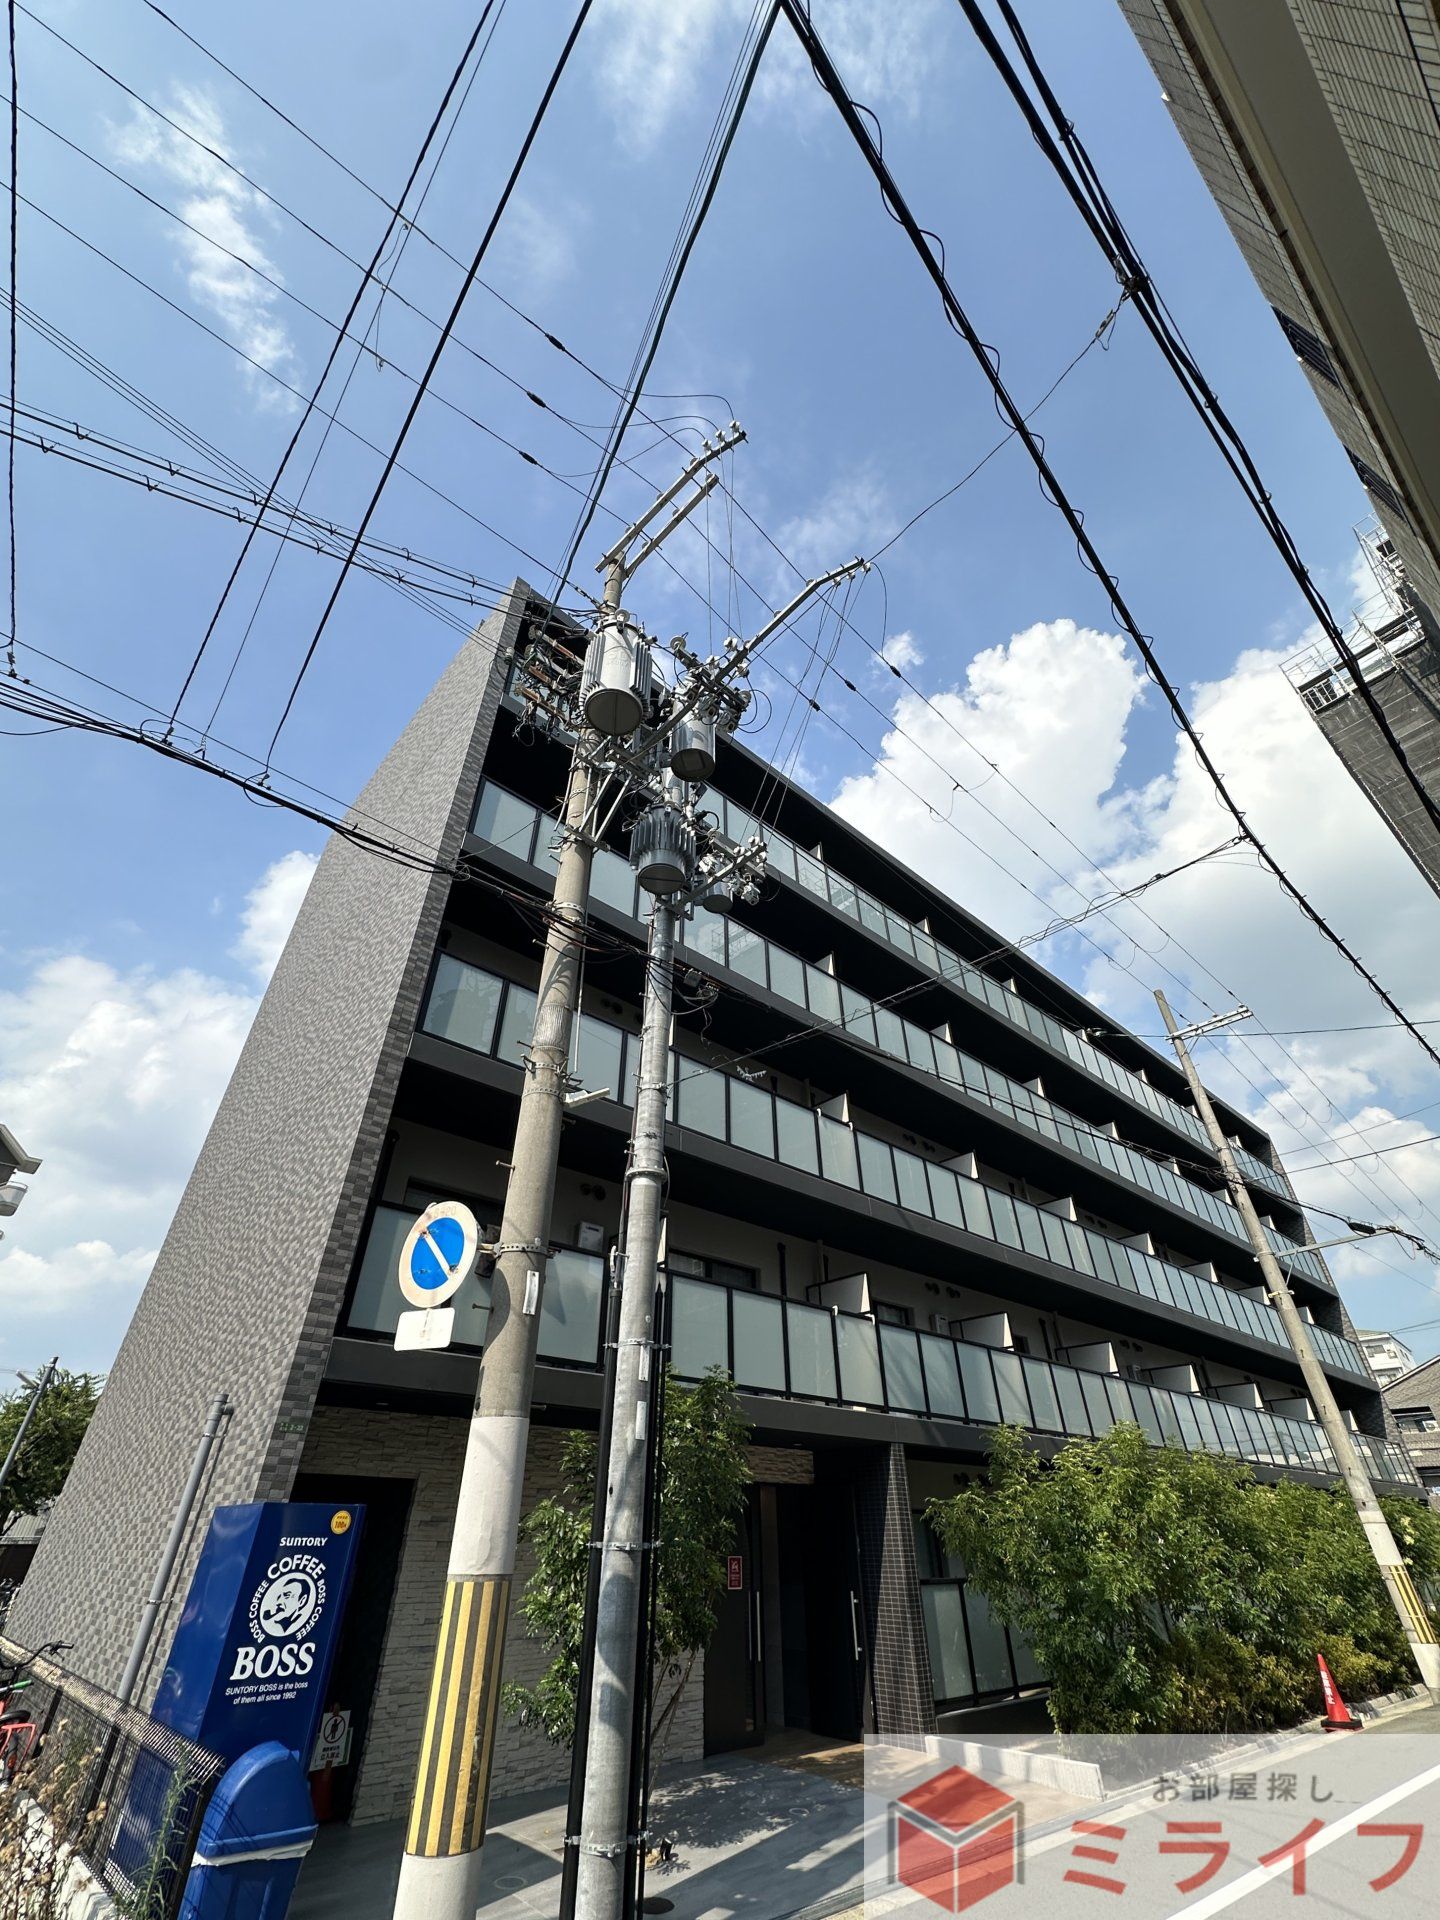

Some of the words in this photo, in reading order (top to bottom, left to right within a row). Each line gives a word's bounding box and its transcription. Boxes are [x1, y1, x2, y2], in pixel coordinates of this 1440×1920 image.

[267, 1554, 326, 1579] COFFEE
[248, 1580, 270, 1618] COFFEE
[317, 1578, 326, 1604] BOSS
[248, 1620, 266, 1643] BOSS
[295, 1606, 322, 1641] COFFEE
[230, 1642, 316, 1680] BOSS
[225, 1685, 258, 1695] SUNTORY
[259, 1683, 278, 1692] BOSS
[284, 1681, 294, 1690] the
[294, 1681, 308, 1689] boss
[233, 1696, 241, 1705] of
[241, 1695, 256, 1703] them
[256, 1694, 266, 1702] all
[265, 1693, 281, 1702] since
